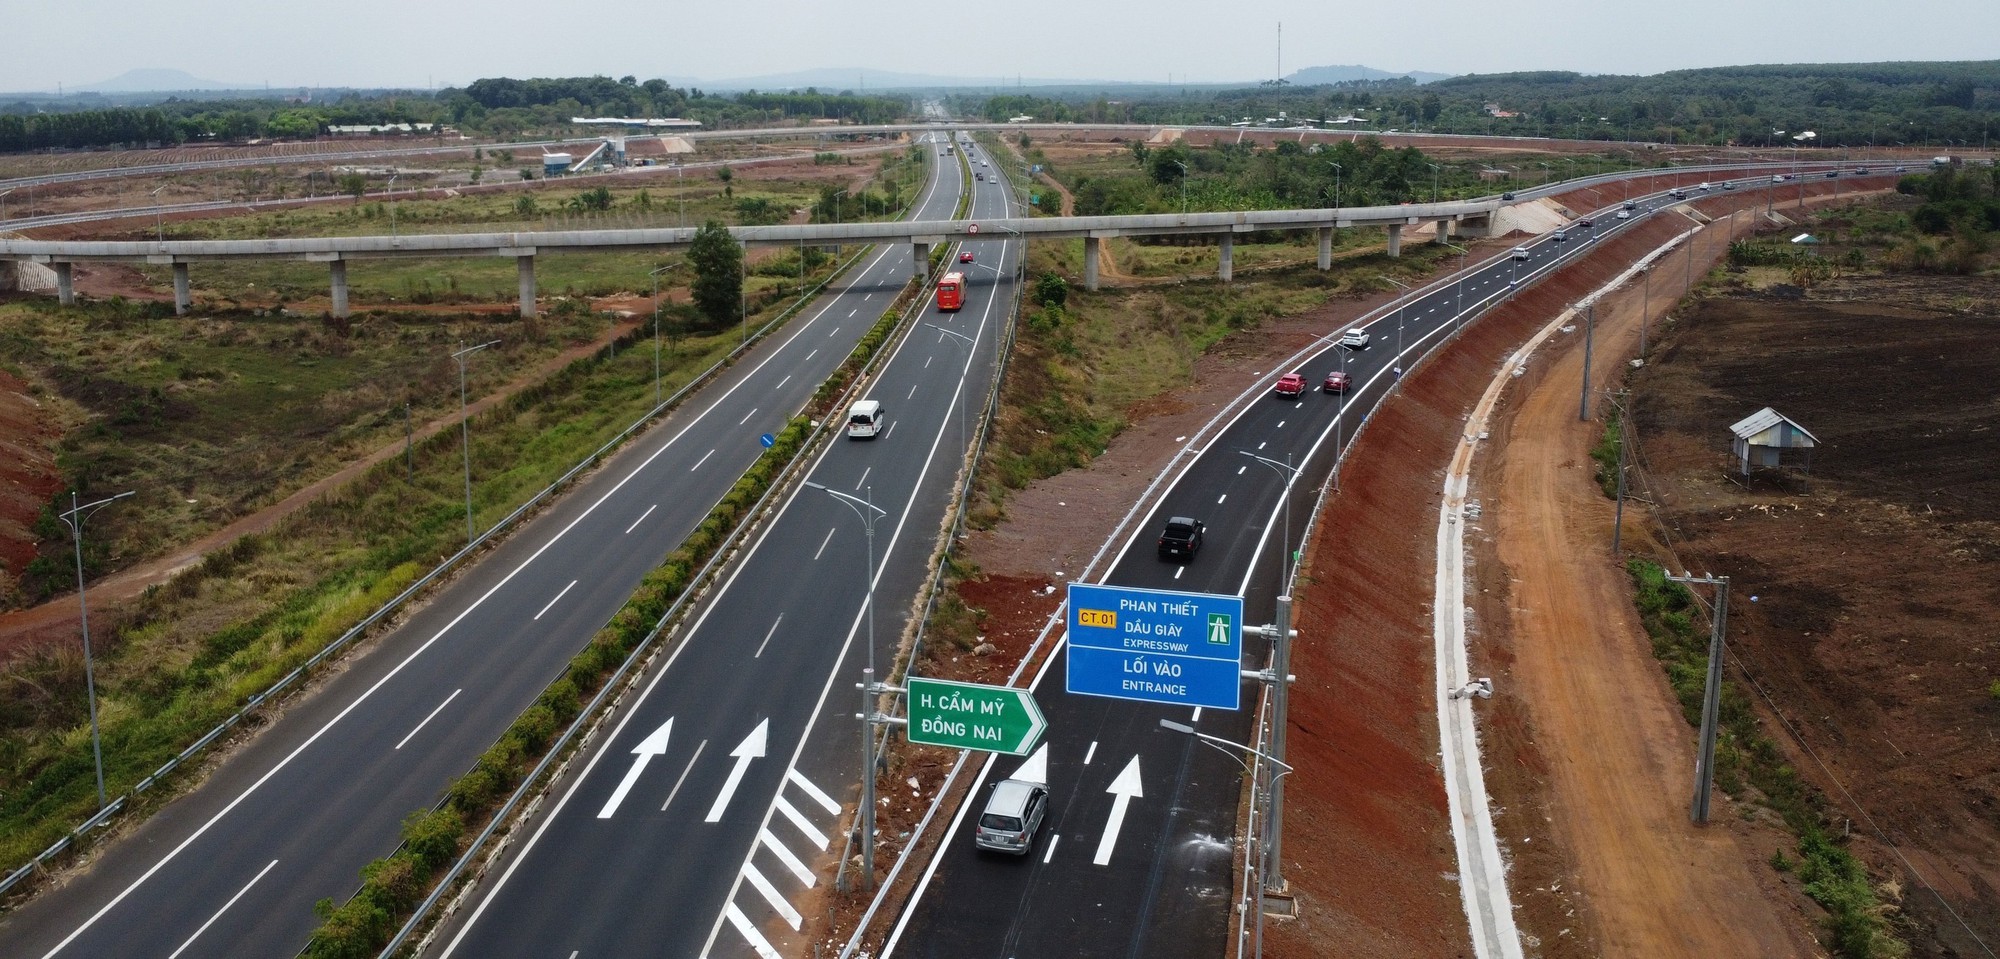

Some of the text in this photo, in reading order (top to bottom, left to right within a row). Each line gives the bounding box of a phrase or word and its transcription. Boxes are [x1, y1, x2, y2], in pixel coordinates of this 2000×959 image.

[1120, 599, 1199, 617] PHAN THIẾT
[1080, 612, 1115, 625] CT.01
[1125, 618, 1183, 637] DẦU GIÂY
[1123, 638, 1189, 652] EXPRESSWAY
[1123, 655, 1182, 677] LỐI VÀO
[1122, 680, 1187, 696] ENTRANCE
[921, 690, 1005, 716] H. CẨM MỸ
[921, 714, 1002, 742] ĐỒNG NAI
